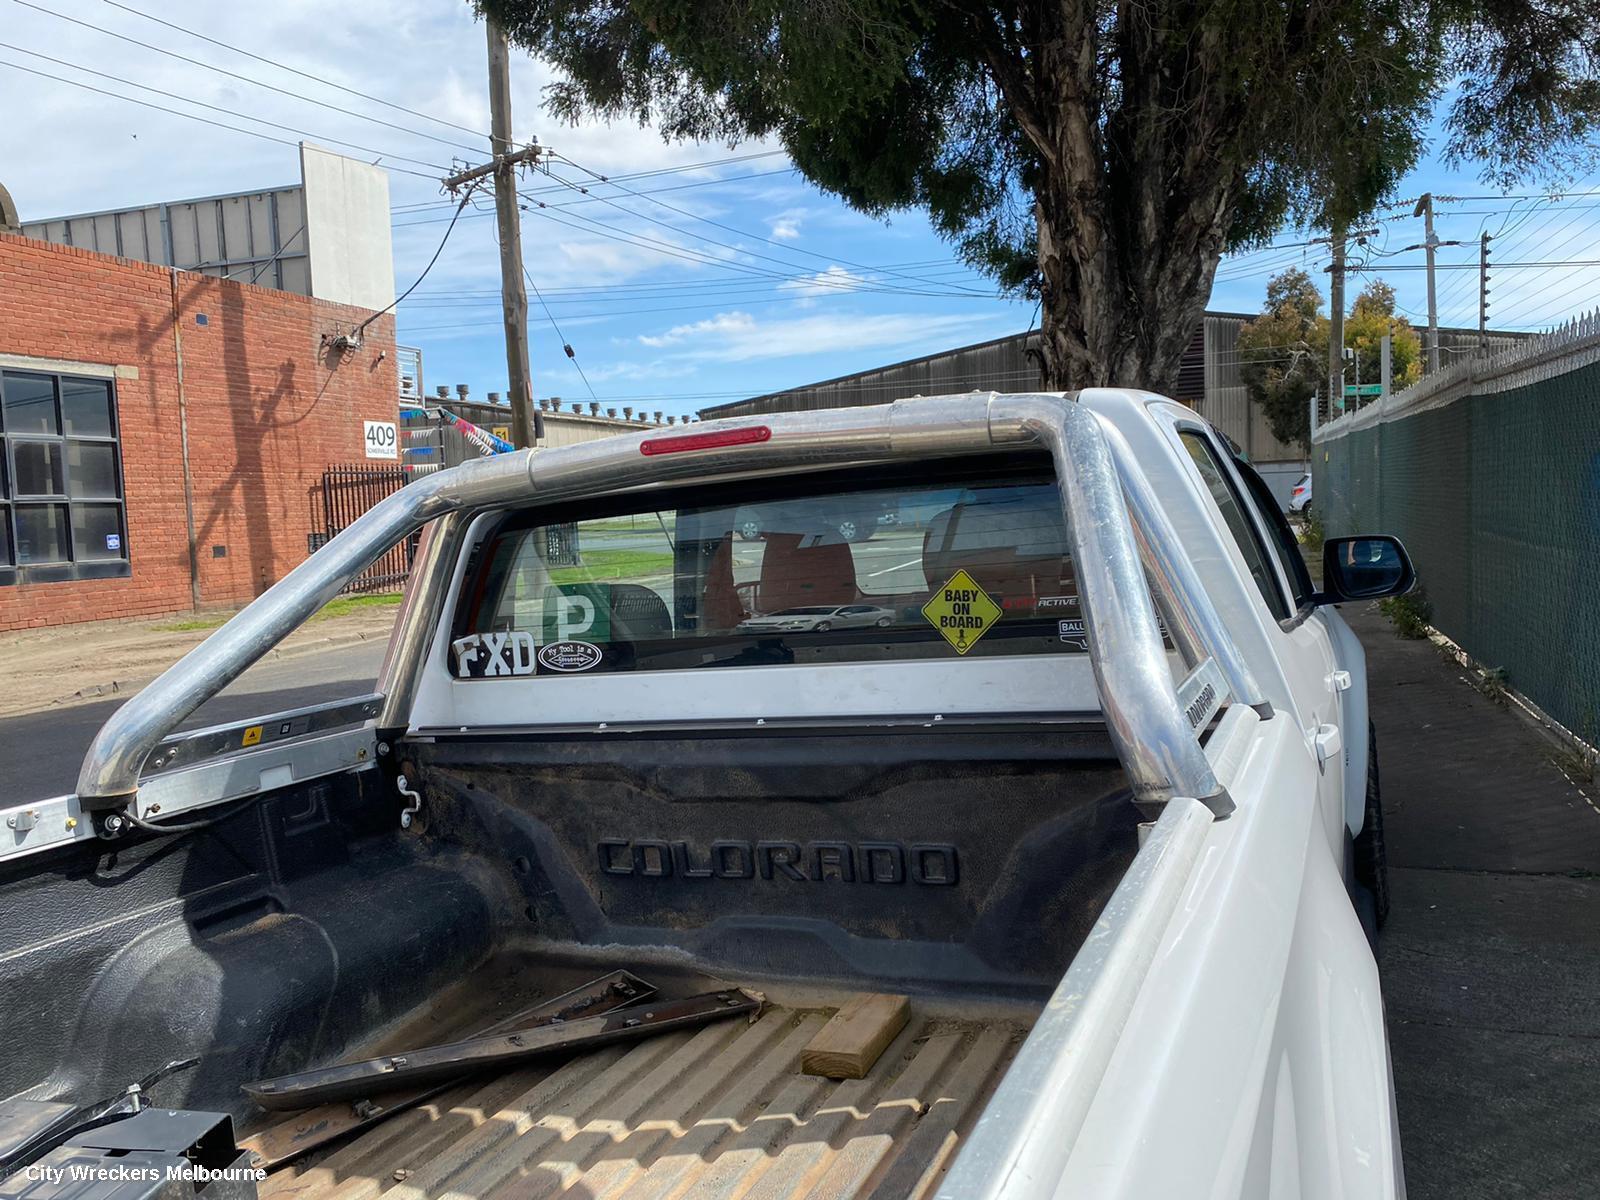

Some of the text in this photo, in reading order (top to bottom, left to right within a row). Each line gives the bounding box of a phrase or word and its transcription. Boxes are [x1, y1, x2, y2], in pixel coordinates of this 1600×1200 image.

[366, 425, 395, 447] 409
[944, 589, 979, 602] BABY
[952, 603, 970, 615] ON
[557, 595, 595, 642] P
[940, 616, 983, 629] BOARD
[598, 838, 960, 886] COLORADO
